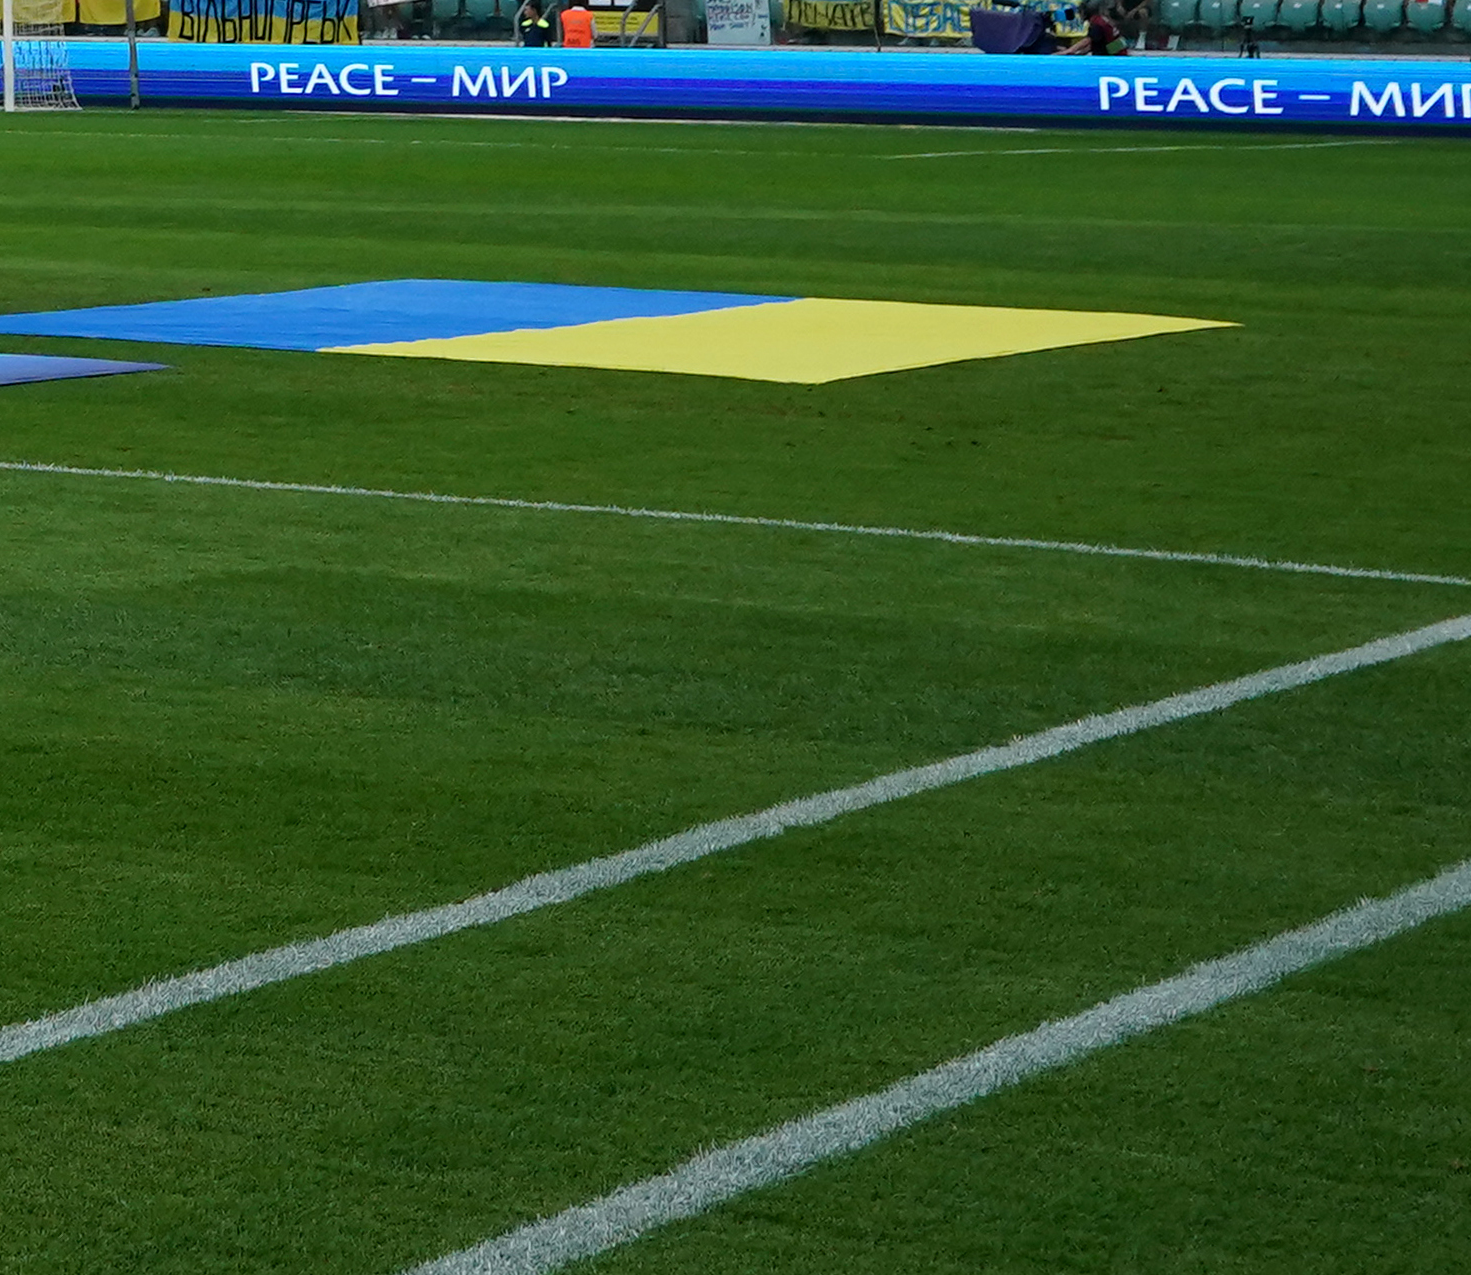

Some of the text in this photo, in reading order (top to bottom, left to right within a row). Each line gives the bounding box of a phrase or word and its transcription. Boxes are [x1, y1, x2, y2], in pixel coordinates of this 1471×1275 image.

[250, 62, 399, 97] PEACE
[451, 64, 569, 100] МИР
[1099, 76, 1284, 117] PEACE
